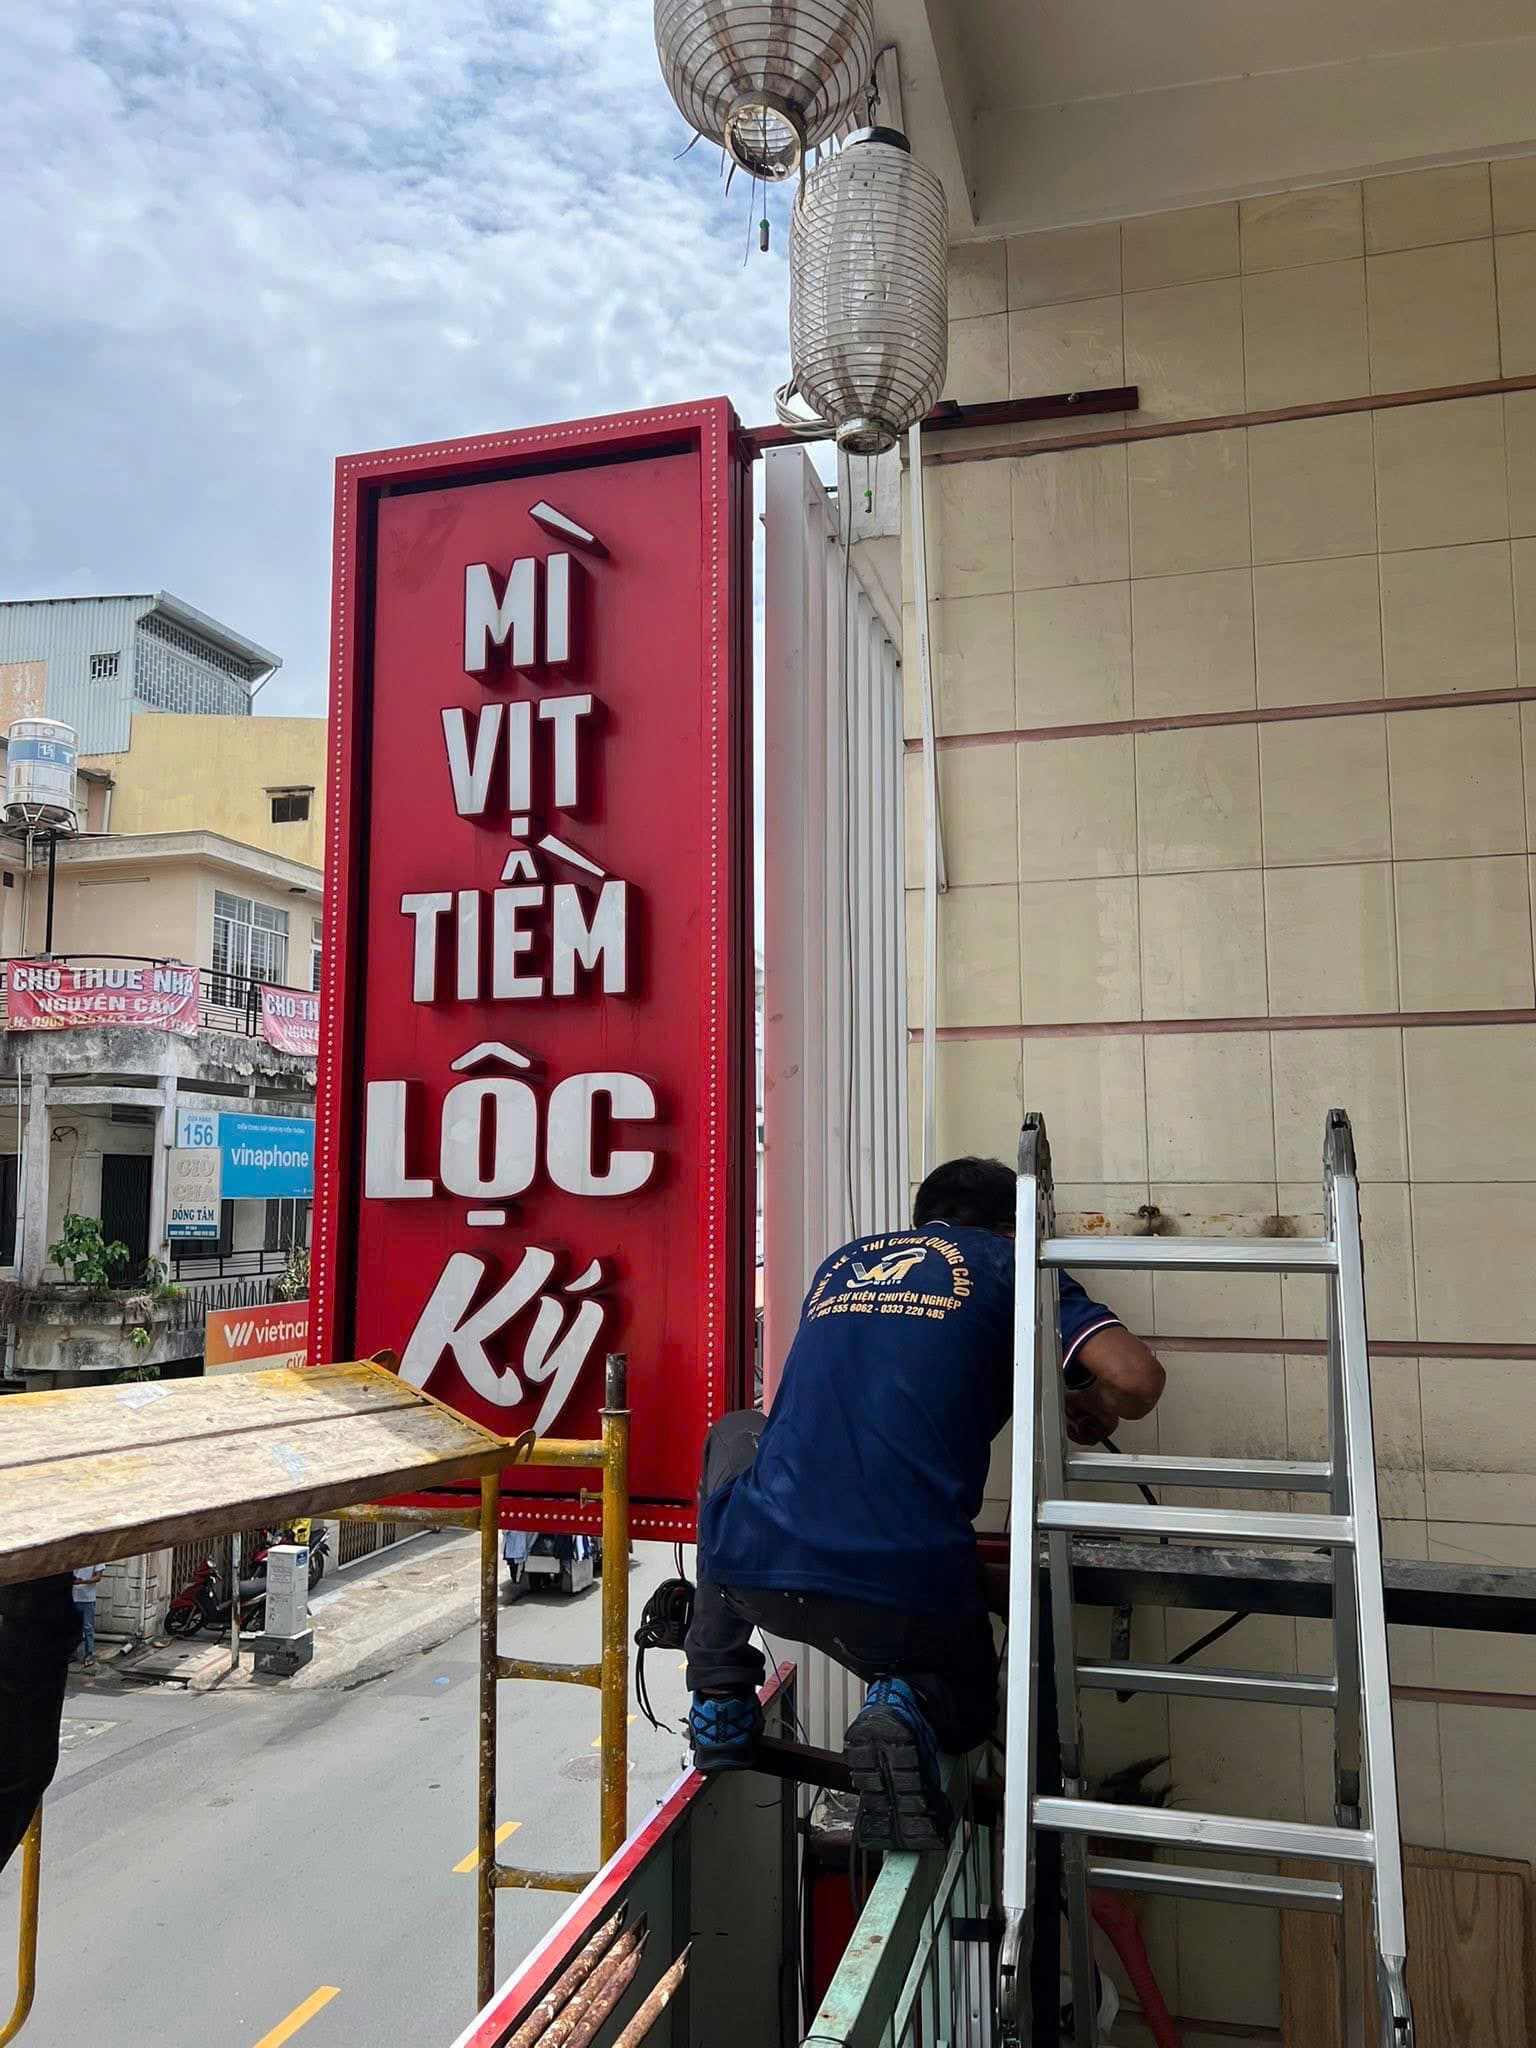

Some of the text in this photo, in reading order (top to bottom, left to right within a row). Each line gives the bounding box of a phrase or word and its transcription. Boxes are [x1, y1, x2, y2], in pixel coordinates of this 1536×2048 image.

[464, 500, 597, 673] MÌ
[441, 693, 593, 837] VỊT
[400, 833, 627, 1003] TIỀM
[12, 967, 62, 992] CHO
[266, 993, 296, 1018] CHO
[184, 1123, 214, 1146] 156
[364, 1041, 657, 1227] LỘC
[231, 1142, 309, 1170] vinaphone
[861, 1239, 885, 1252] THI
[925, 1236, 965, 1265] QUẢNG
[952, 1267, 974, 1297] CÁO
[852, 1289, 876, 1303] KIỆN
[878, 1290, 919, 1303] CHUYÊN
[920, 1294, 962, 1311] NGHIỆP
[880, 1304, 904, 1314] 0333
[905, 1305, 925, 1317] 220
[255, 1318, 308, 1344] vietna
[400, 1246, 605, 1438] Ký
